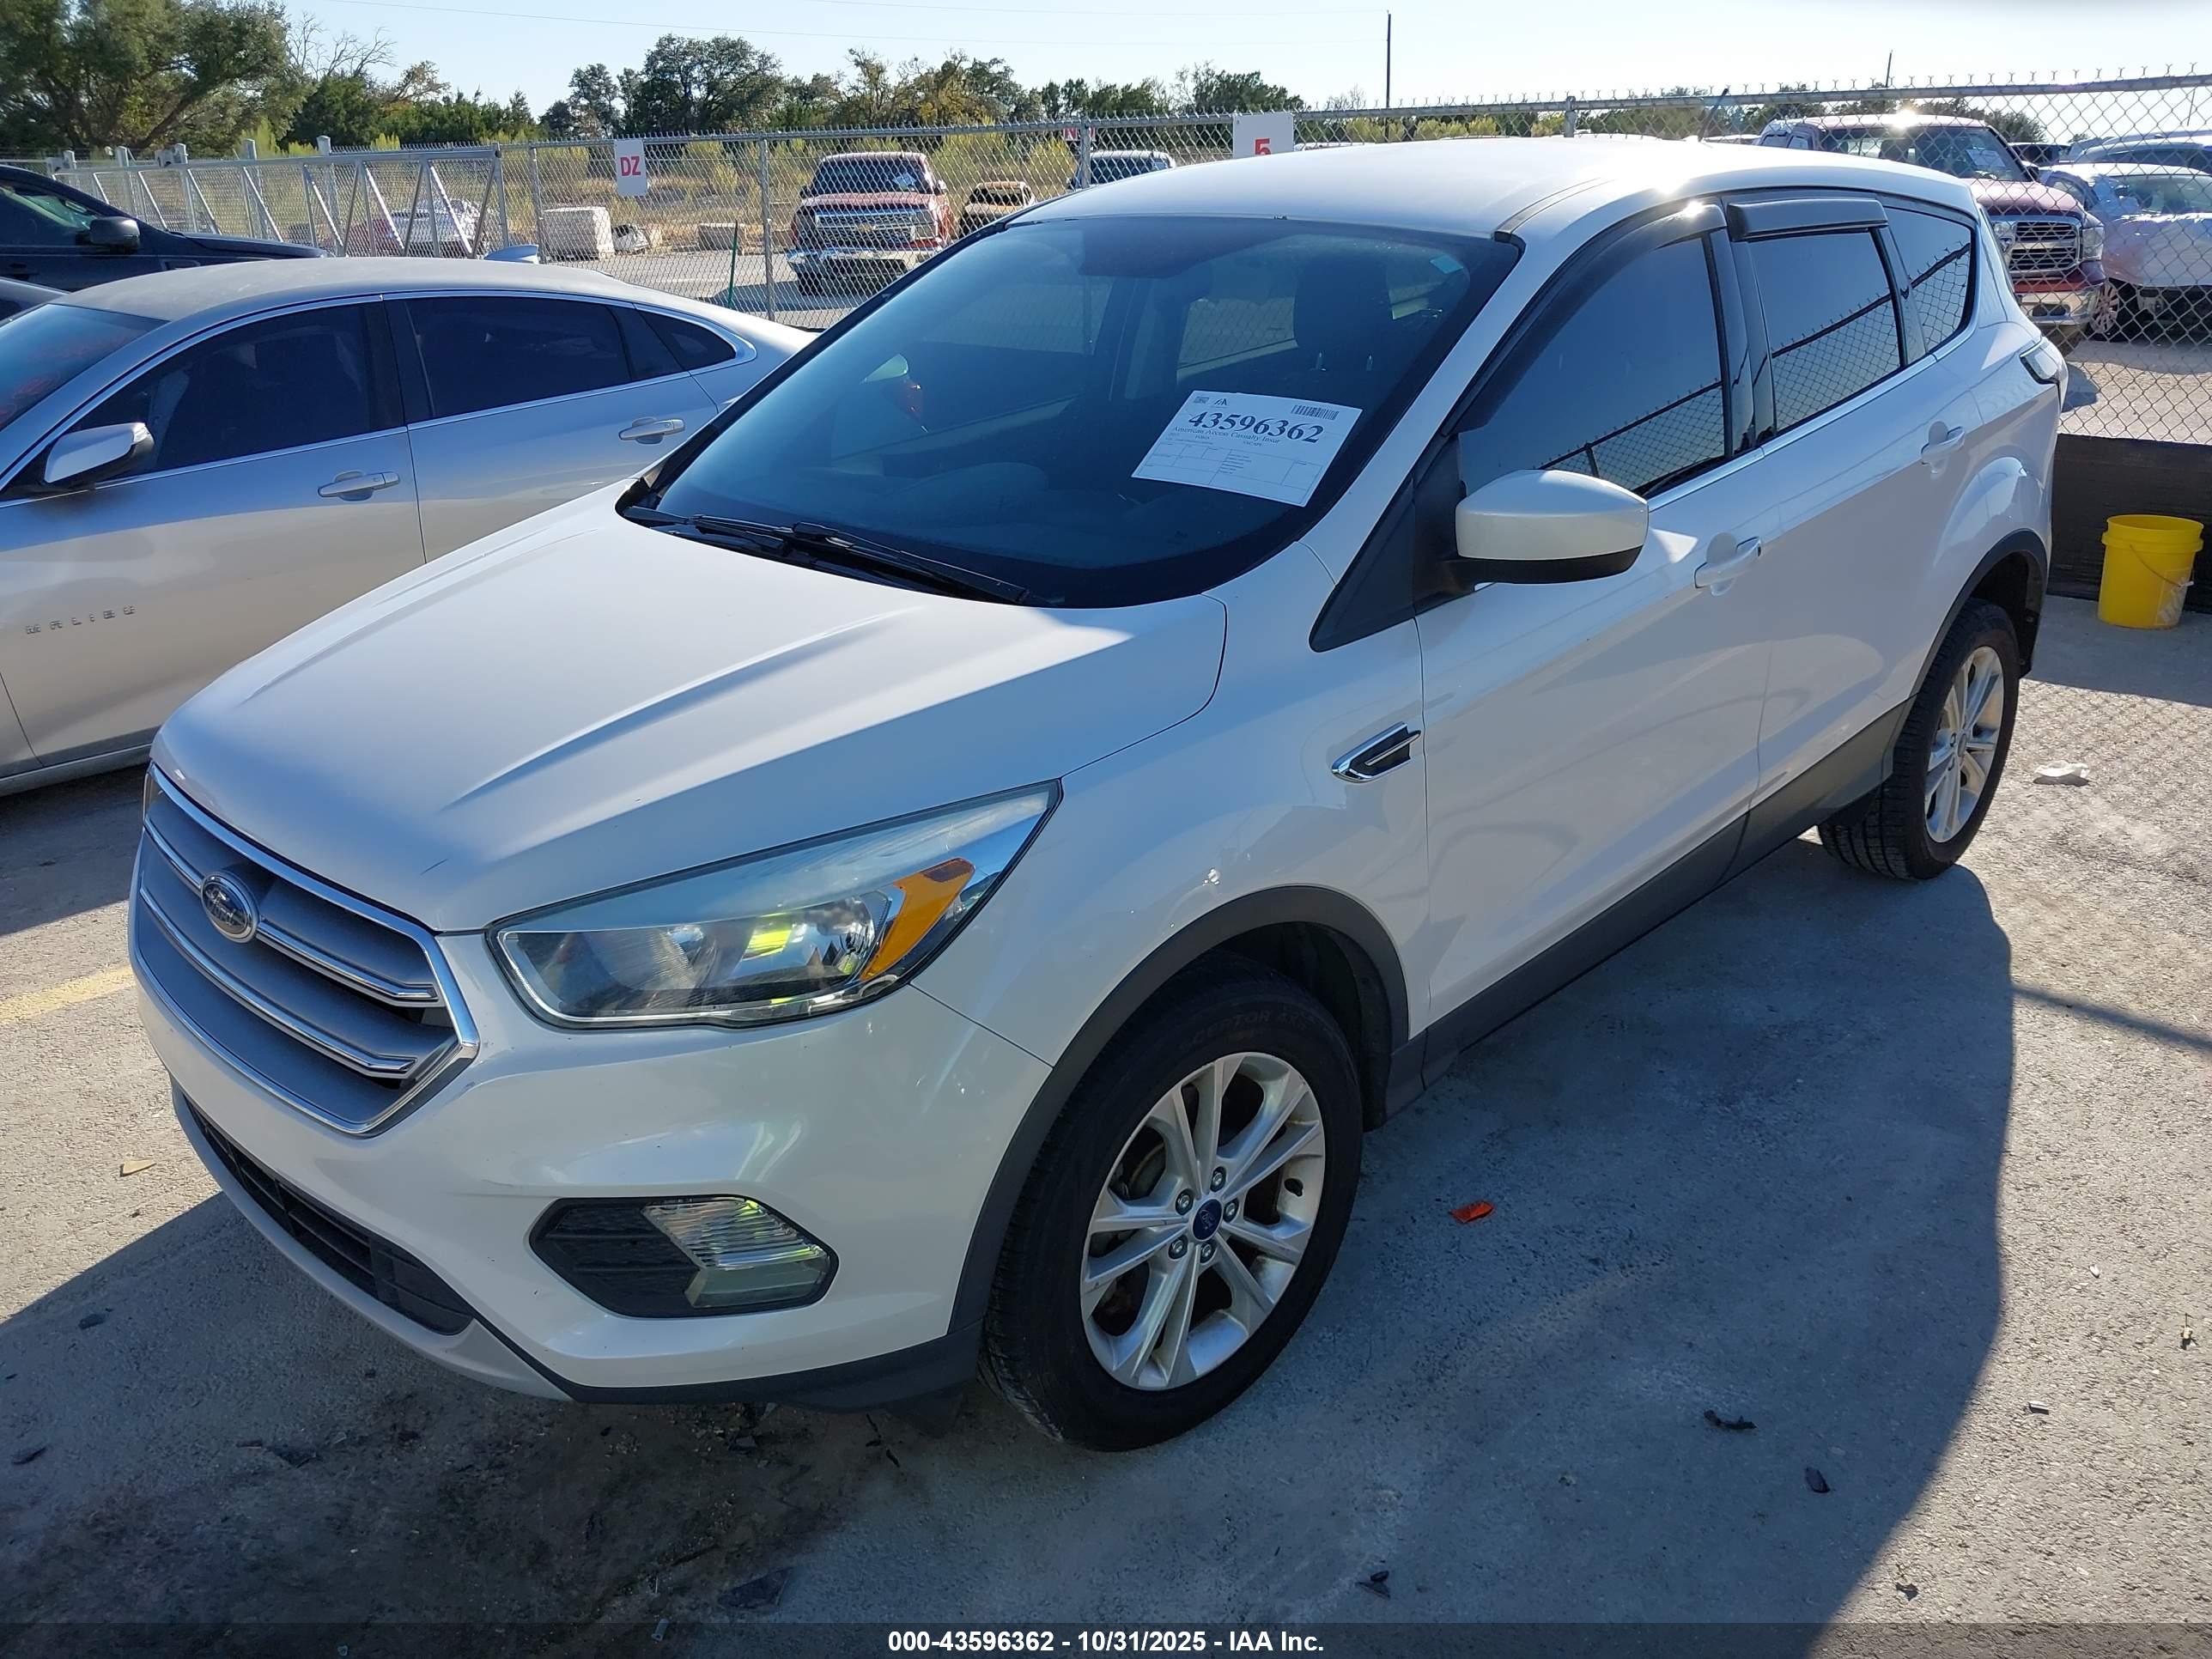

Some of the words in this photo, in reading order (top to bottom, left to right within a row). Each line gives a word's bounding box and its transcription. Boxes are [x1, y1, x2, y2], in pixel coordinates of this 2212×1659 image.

[1255, 137, 1272, 155] 5
[620, 155, 641, 176] DZ
[1188, 411, 1324, 443] 43596362
[26, 605, 136, 635] MALIBU
